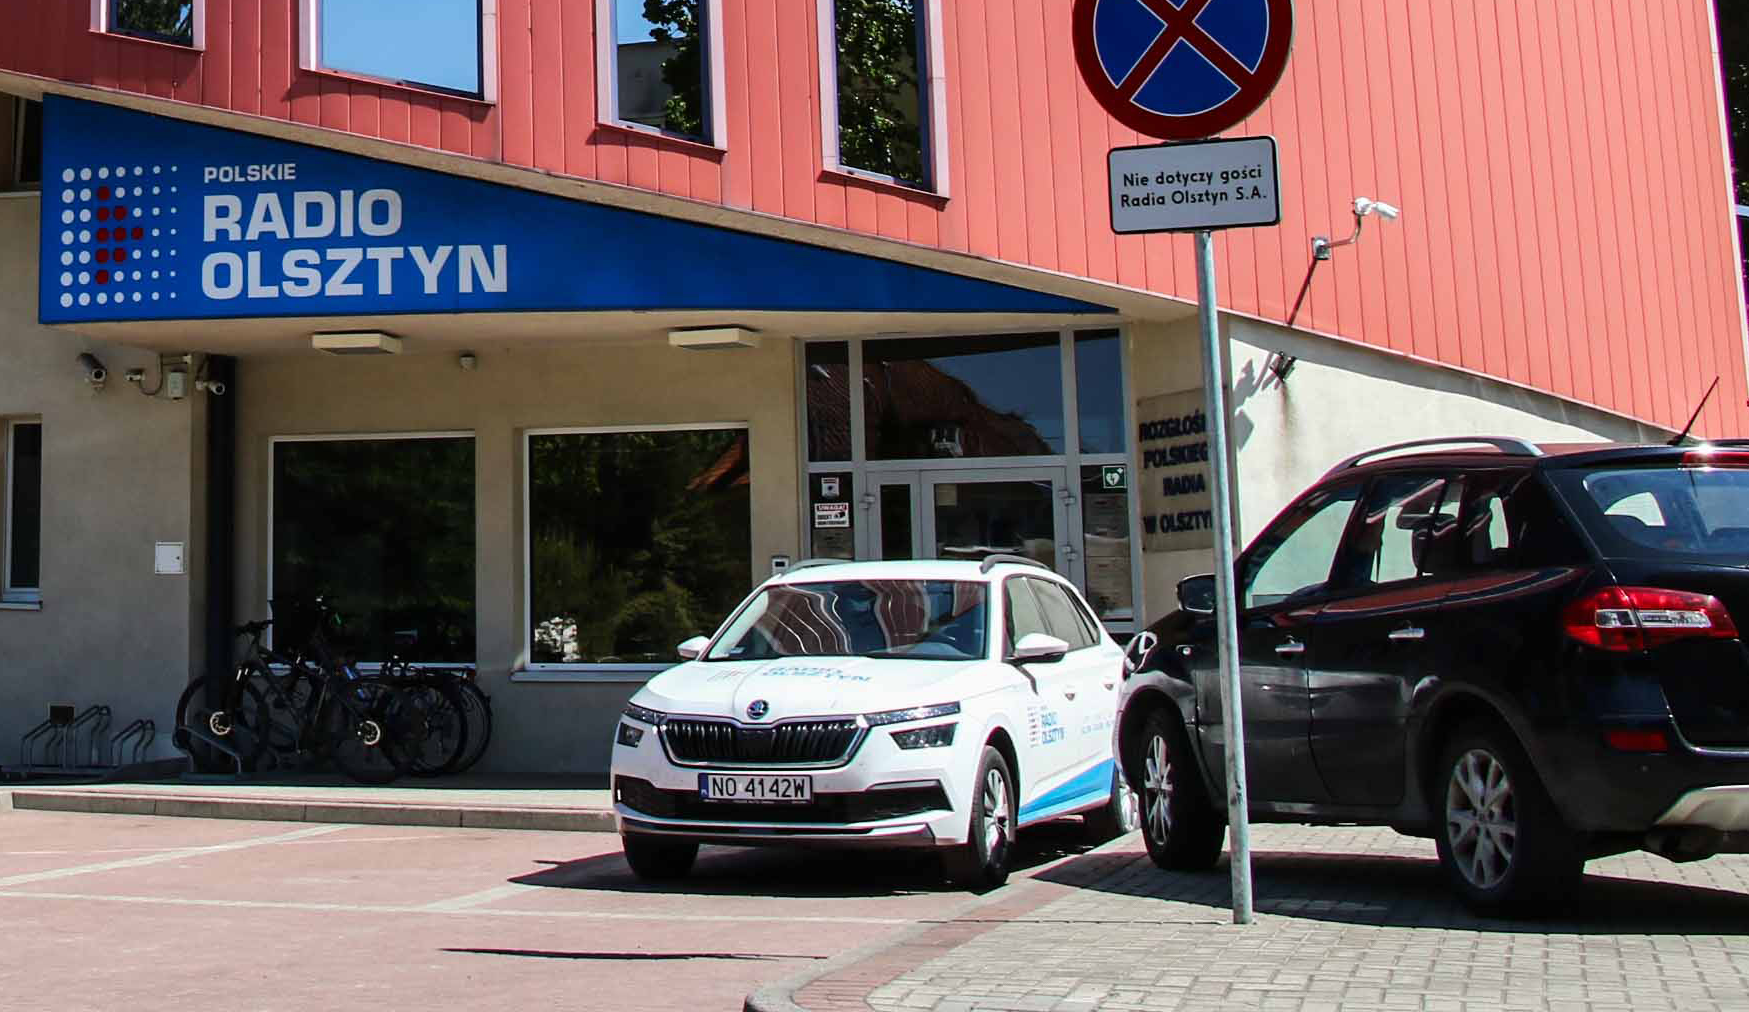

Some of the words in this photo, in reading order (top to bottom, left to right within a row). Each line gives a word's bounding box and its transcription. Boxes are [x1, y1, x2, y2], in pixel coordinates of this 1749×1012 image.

[204, 163, 296, 184] POLSKIE
[1123, 172, 1150, 188] Nie
[1155, 171, 1214, 188] dotyczy
[1220, 163, 1262, 185] gości
[1120, 192, 1166, 208] Radia
[1171, 189, 1229, 206] Olsztyn
[1235, 185, 1267, 201] S.A.
[203, 188, 402, 242] RADIO
[201, 244, 508, 300] OLSZTYN
[1143, 440, 1209, 469] POLSKIEG
[1163, 473, 1206, 497] RADIA
[1143, 514, 1157, 534] W
[1160, 510, 1213, 533] OLSZTY
[712, 777, 737, 797] NO
[744, 778, 805, 798] 4142W
